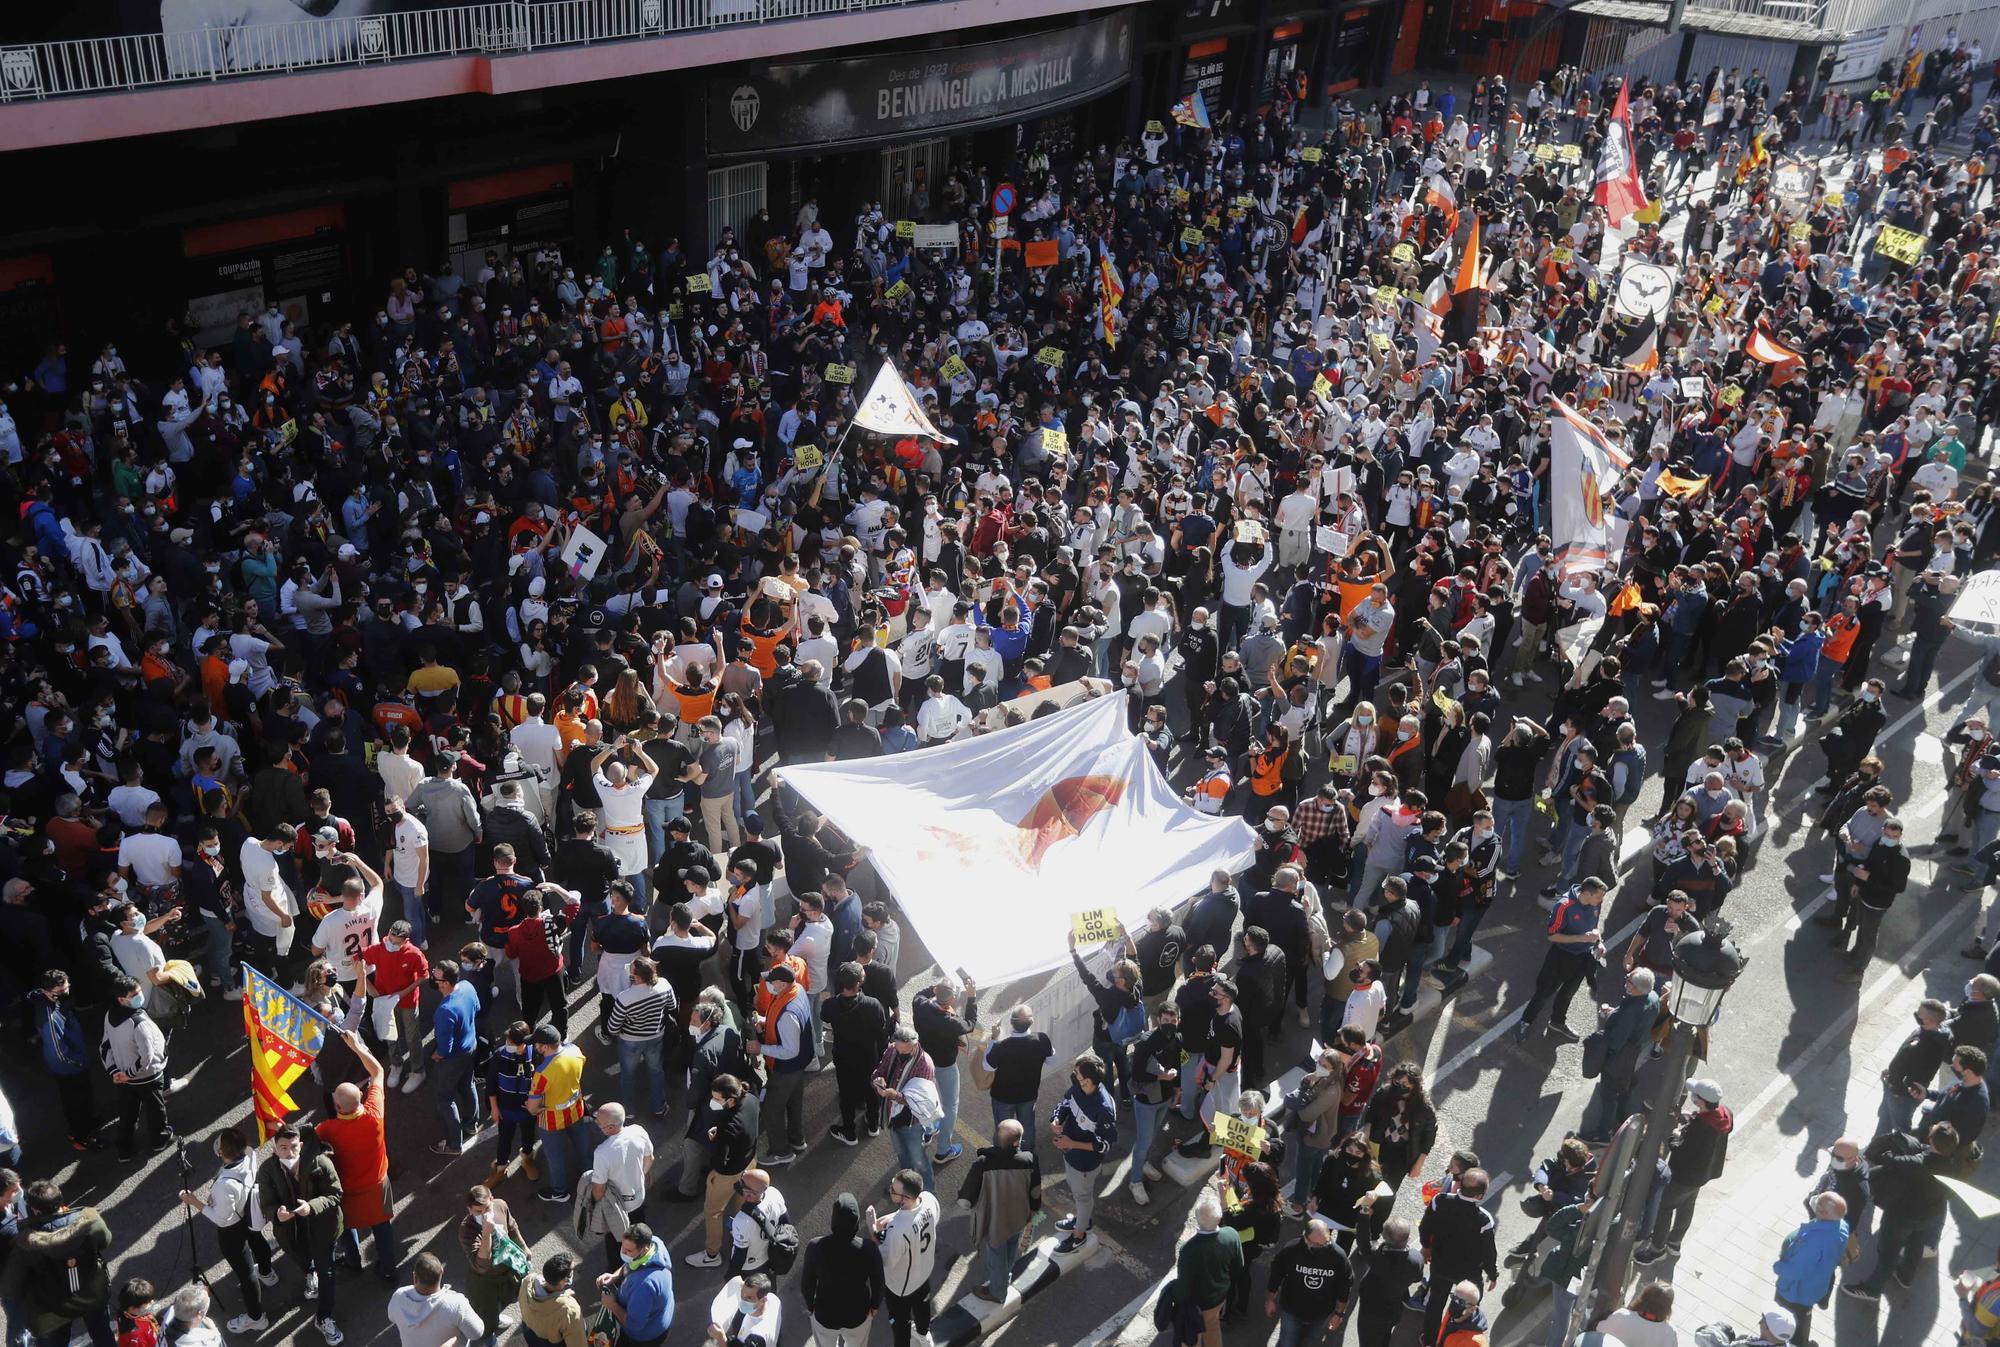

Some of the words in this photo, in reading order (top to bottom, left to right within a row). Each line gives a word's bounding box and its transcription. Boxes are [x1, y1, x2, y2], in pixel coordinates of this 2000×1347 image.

[889, 69, 907, 83] Des
[909, 66, 921, 80] de
[924, 63, 949, 78] 1923
[877, 73, 994, 121] BENVINGUTS
[997, 74, 1007, 100] A
[1011, 65, 1072, 98] MESTALLA
[1892, 237, 1907, 246] GO
[1875, 239, 1917, 264] HOME
[218, 259, 261, 276] EQUIPACIÓN
[828, 374, 848, 382] HOME
[802, 446, 814, 454] LIM
[1046, 442, 1062, 451] HOME
[800, 458, 818, 468] HOME
[958, 642, 968, 658] 7
[500, 893, 518, 919] 9
[344, 917, 368, 929] AIMAR
[1082, 910, 1103, 922] LIM
[1085, 920, 1103, 931] GO
[344, 928, 373, 958] 21
[1078, 928, 1114, 943] HOME
[1227, 1120, 1249, 1135] LIM
[1216, 1136, 1253, 1154] HOME
[1226, 1131, 1245, 1144] GO
[920, 1222, 930, 1253] 5
[1296, 1264, 1334, 1277] LIBERTAD
